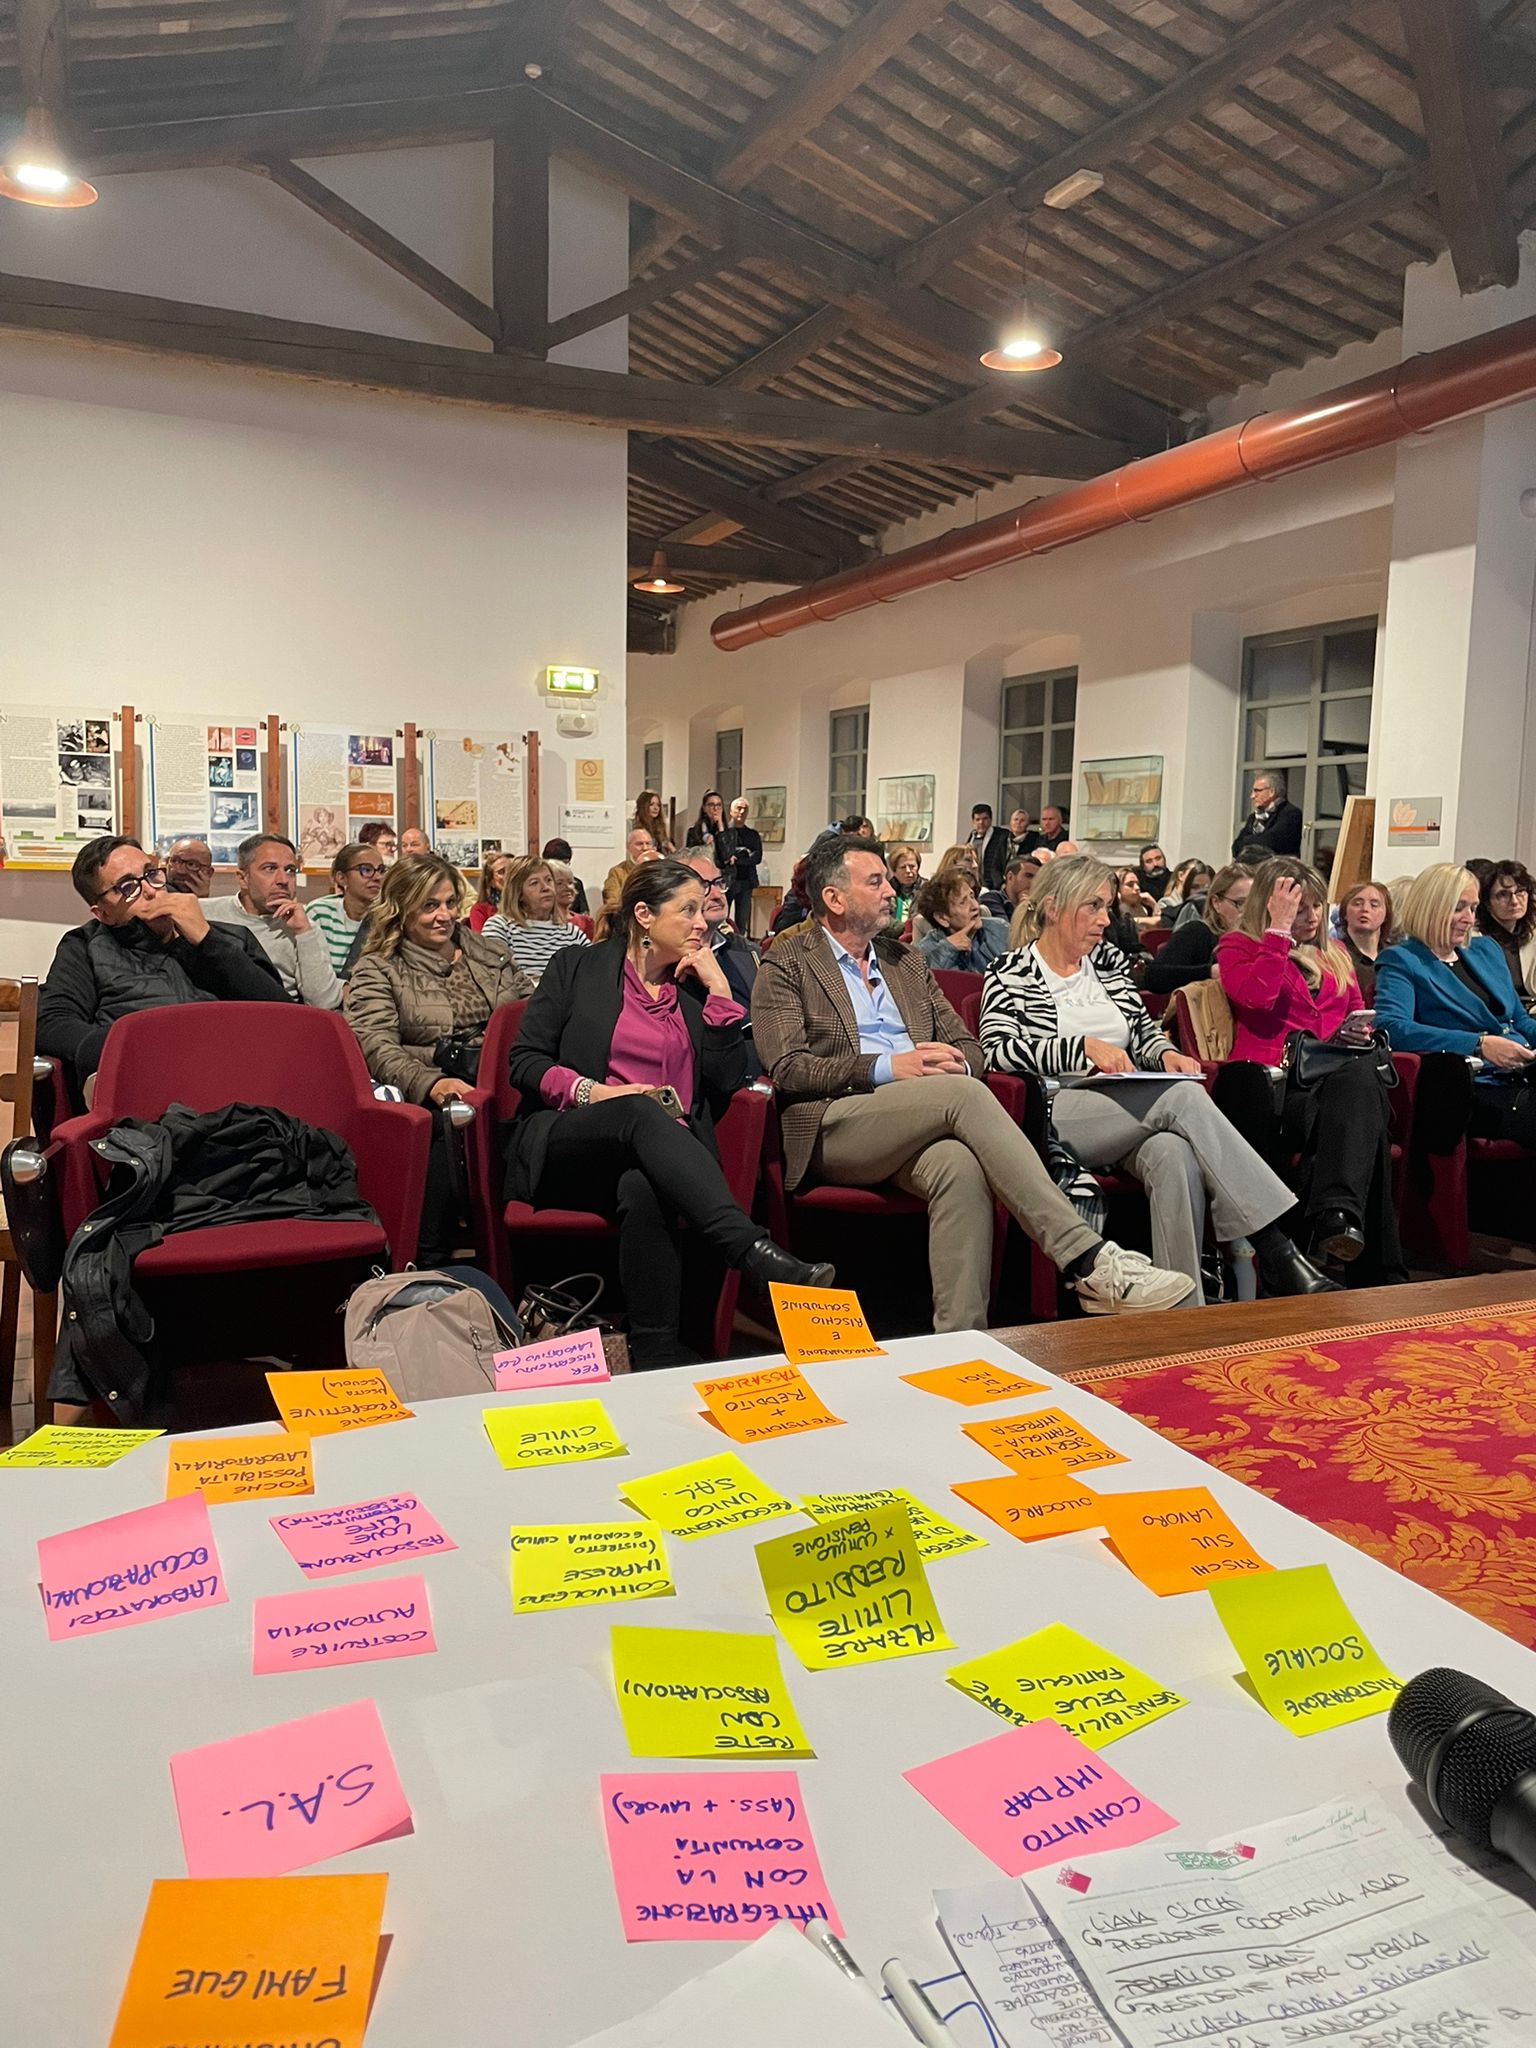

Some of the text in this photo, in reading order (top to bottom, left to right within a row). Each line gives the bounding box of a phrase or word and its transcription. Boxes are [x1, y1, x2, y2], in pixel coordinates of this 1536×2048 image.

[781, 1300, 850, 1312] SOLITUDINE
[811, 1316, 863, 1328] RISCHIO
[832, 1332, 840, 1340] E
[571, 1364, 599, 1375] PER
[704, 1369, 800, 1396] TASSAZIONE
[288, 1400, 397, 1419] PROSPETTIVE
[725, 1389, 806, 1412] REDDITO
[339, 1410, 406, 1428] POCHE
[745, 1416, 836, 1438] PENSIONE
[990, 1415, 1060, 1435] IMPRESA
[521, 1426, 596, 1445] CIVILE
[174, 1450, 308, 1471] LABORATORIALI
[517, 1441, 613, 1458] SERVIZIO
[1061, 1450, 1116, 1467] RETE
[233, 1478, 309, 1494] POCHE
[663, 1478, 736, 1500] S.A.L.
[685, 1492, 757, 1518] UNICO
[1006, 1497, 1092, 1522] OLLOCARE
[344, 1516, 400, 1535] LIFE
[671, 1501, 792, 1537] REGOLAMENTO
[1143, 1508, 1212, 1527] LAVORO
[349, 1522, 411, 1545] LOVE
[568, 1531, 642, 1544] ECONOMIA
[792, 1518, 871, 1556] PENSIONE
[1191, 1534, 1234, 1549] SUL
[574, 1539, 656, 1555] (DISTRETTO
[817, 1531, 878, 1561] CUMULO
[46, 1548, 208, 1608] OCCUPAZIONALI
[563, 1559, 661, 1582] IMPRESE
[1190, 1559, 1259, 1576] RISCHI
[519, 1580, 670, 1605] COINVOLGERE
[785, 1550, 906, 1613] REDDITO
[69, 1576, 217, 1628] LABORATORI
[817, 1589, 912, 1638] LIMITE
[267, 1603, 415, 1640] AUTONOMIA
[291, 1631, 427, 1658] COSTRUIRE
[823, 1620, 935, 1659] ALZARE
[1264, 1636, 1364, 1676] SOCIALE
[1016, 1666, 1125, 1692] FAMIGLIE
[623, 1680, 770, 1704] ASSOCIAZIONI
[1055, 1689, 1127, 1714] DELLE
[1284, 1677, 1403, 1717] RISTORAZIONE
[721, 1712, 780, 1728] CON
[715, 1735, 794, 1750] RETE
[222, 1764, 375, 1831] S.A.L.
[612, 1792, 795, 1824] (ASS. + LAVORO)
[1022, 1796, 1141, 1852] CONVITTO
[675, 1869, 807, 1889] CON LA
[1360, 1873, 1409, 1898] ASAD
[636, 1902, 828, 1924] INTEGRAZIONE
[165, 1965, 347, 2002] FAMIGLIE
